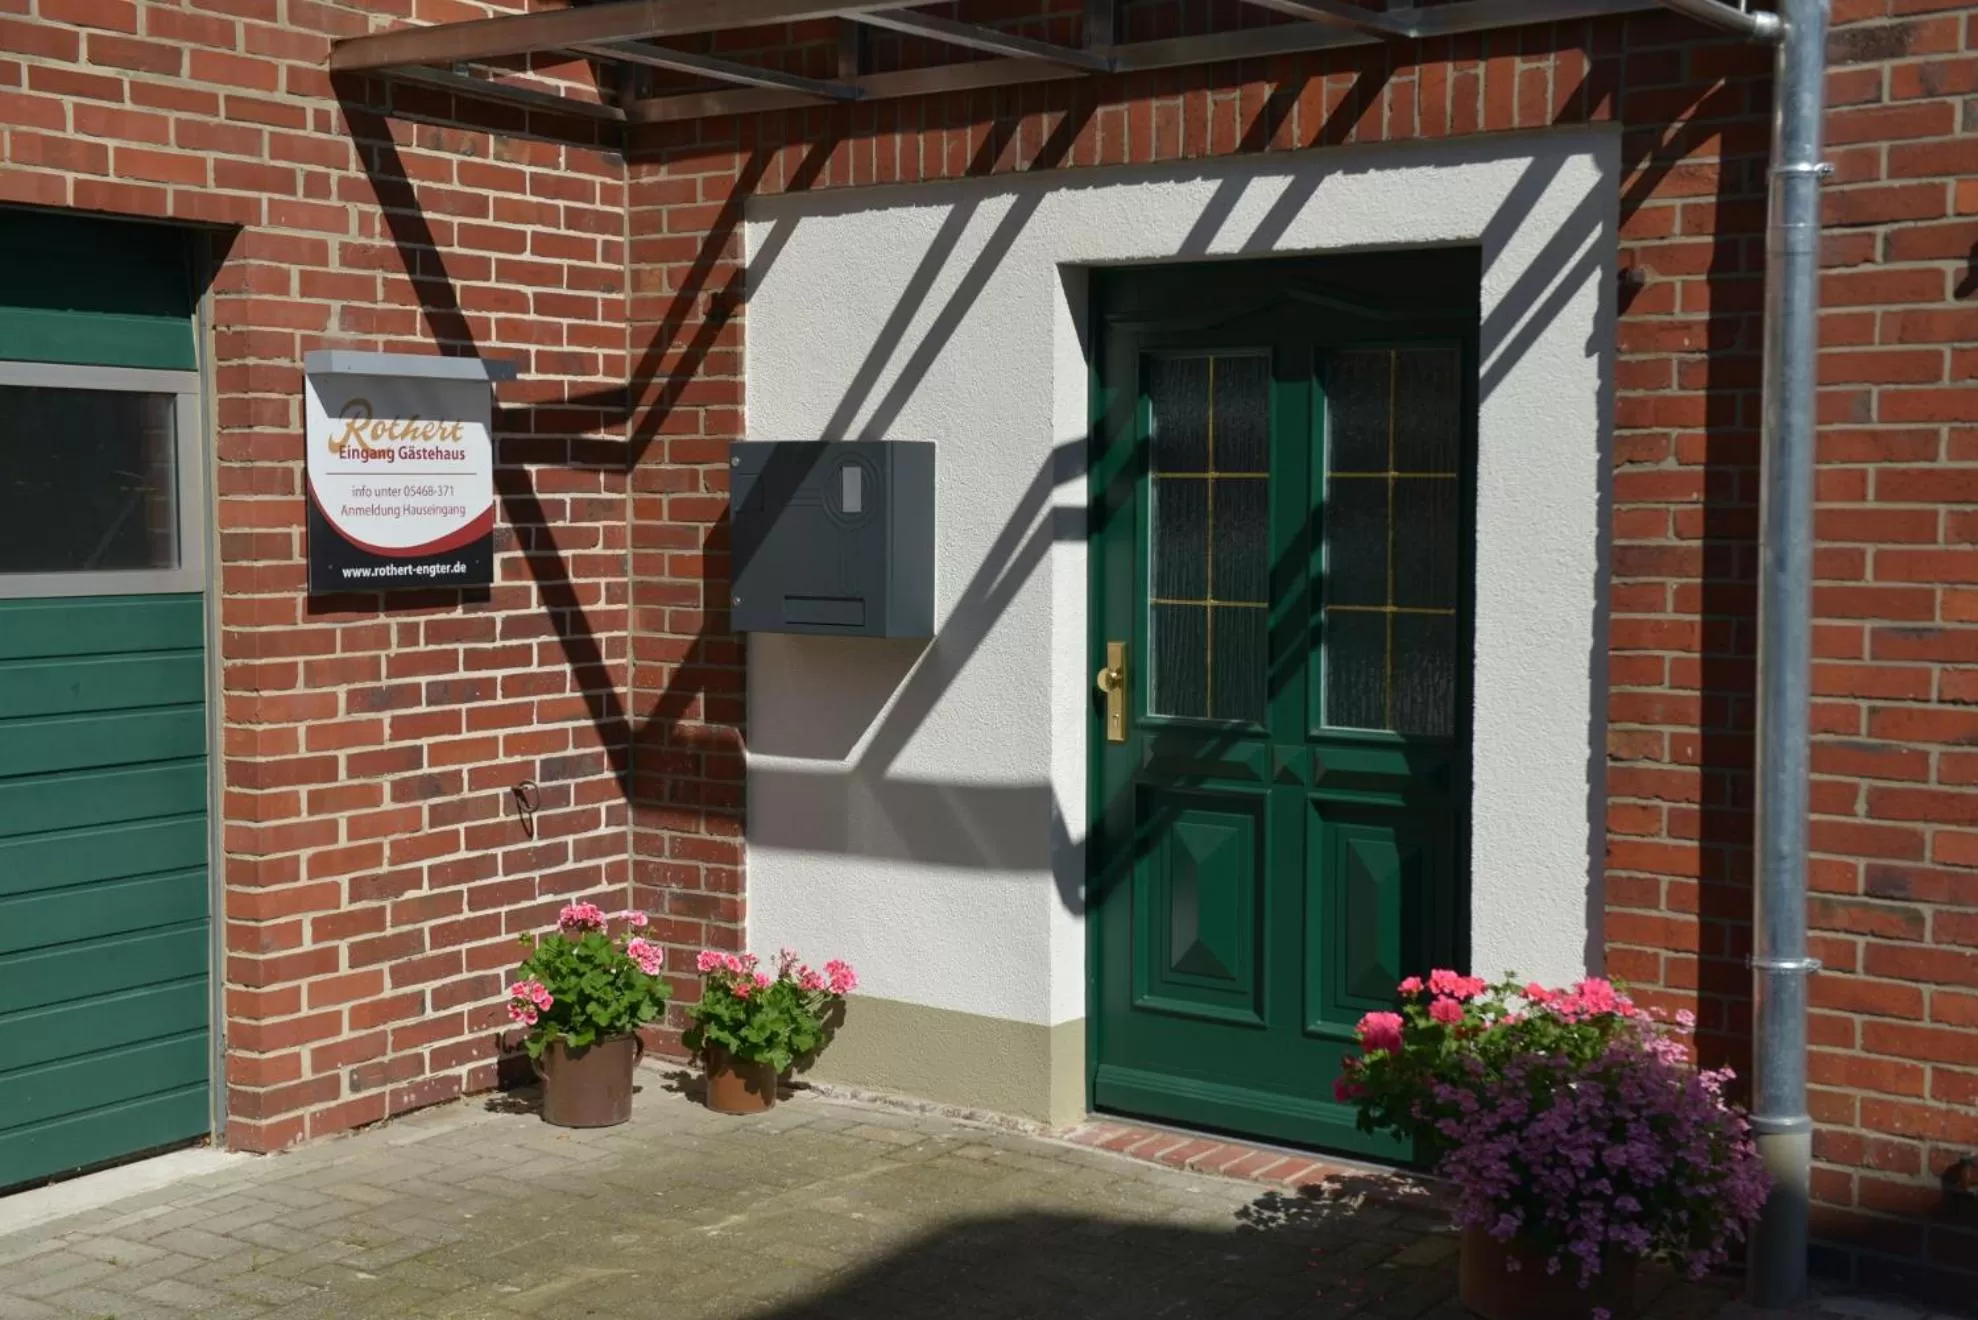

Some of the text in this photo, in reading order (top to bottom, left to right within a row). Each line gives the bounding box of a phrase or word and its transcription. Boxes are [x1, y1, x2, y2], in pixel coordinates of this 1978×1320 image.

[328, 398, 464, 455] Rothert
[339, 445, 466, 463] Eingang Gästehaus
[352, 485, 455, 498] info unter 05468-371
[340, 504, 466, 518] Anmeldung Hauseingang
[342, 561, 467, 579] www.rothert-engter.de
